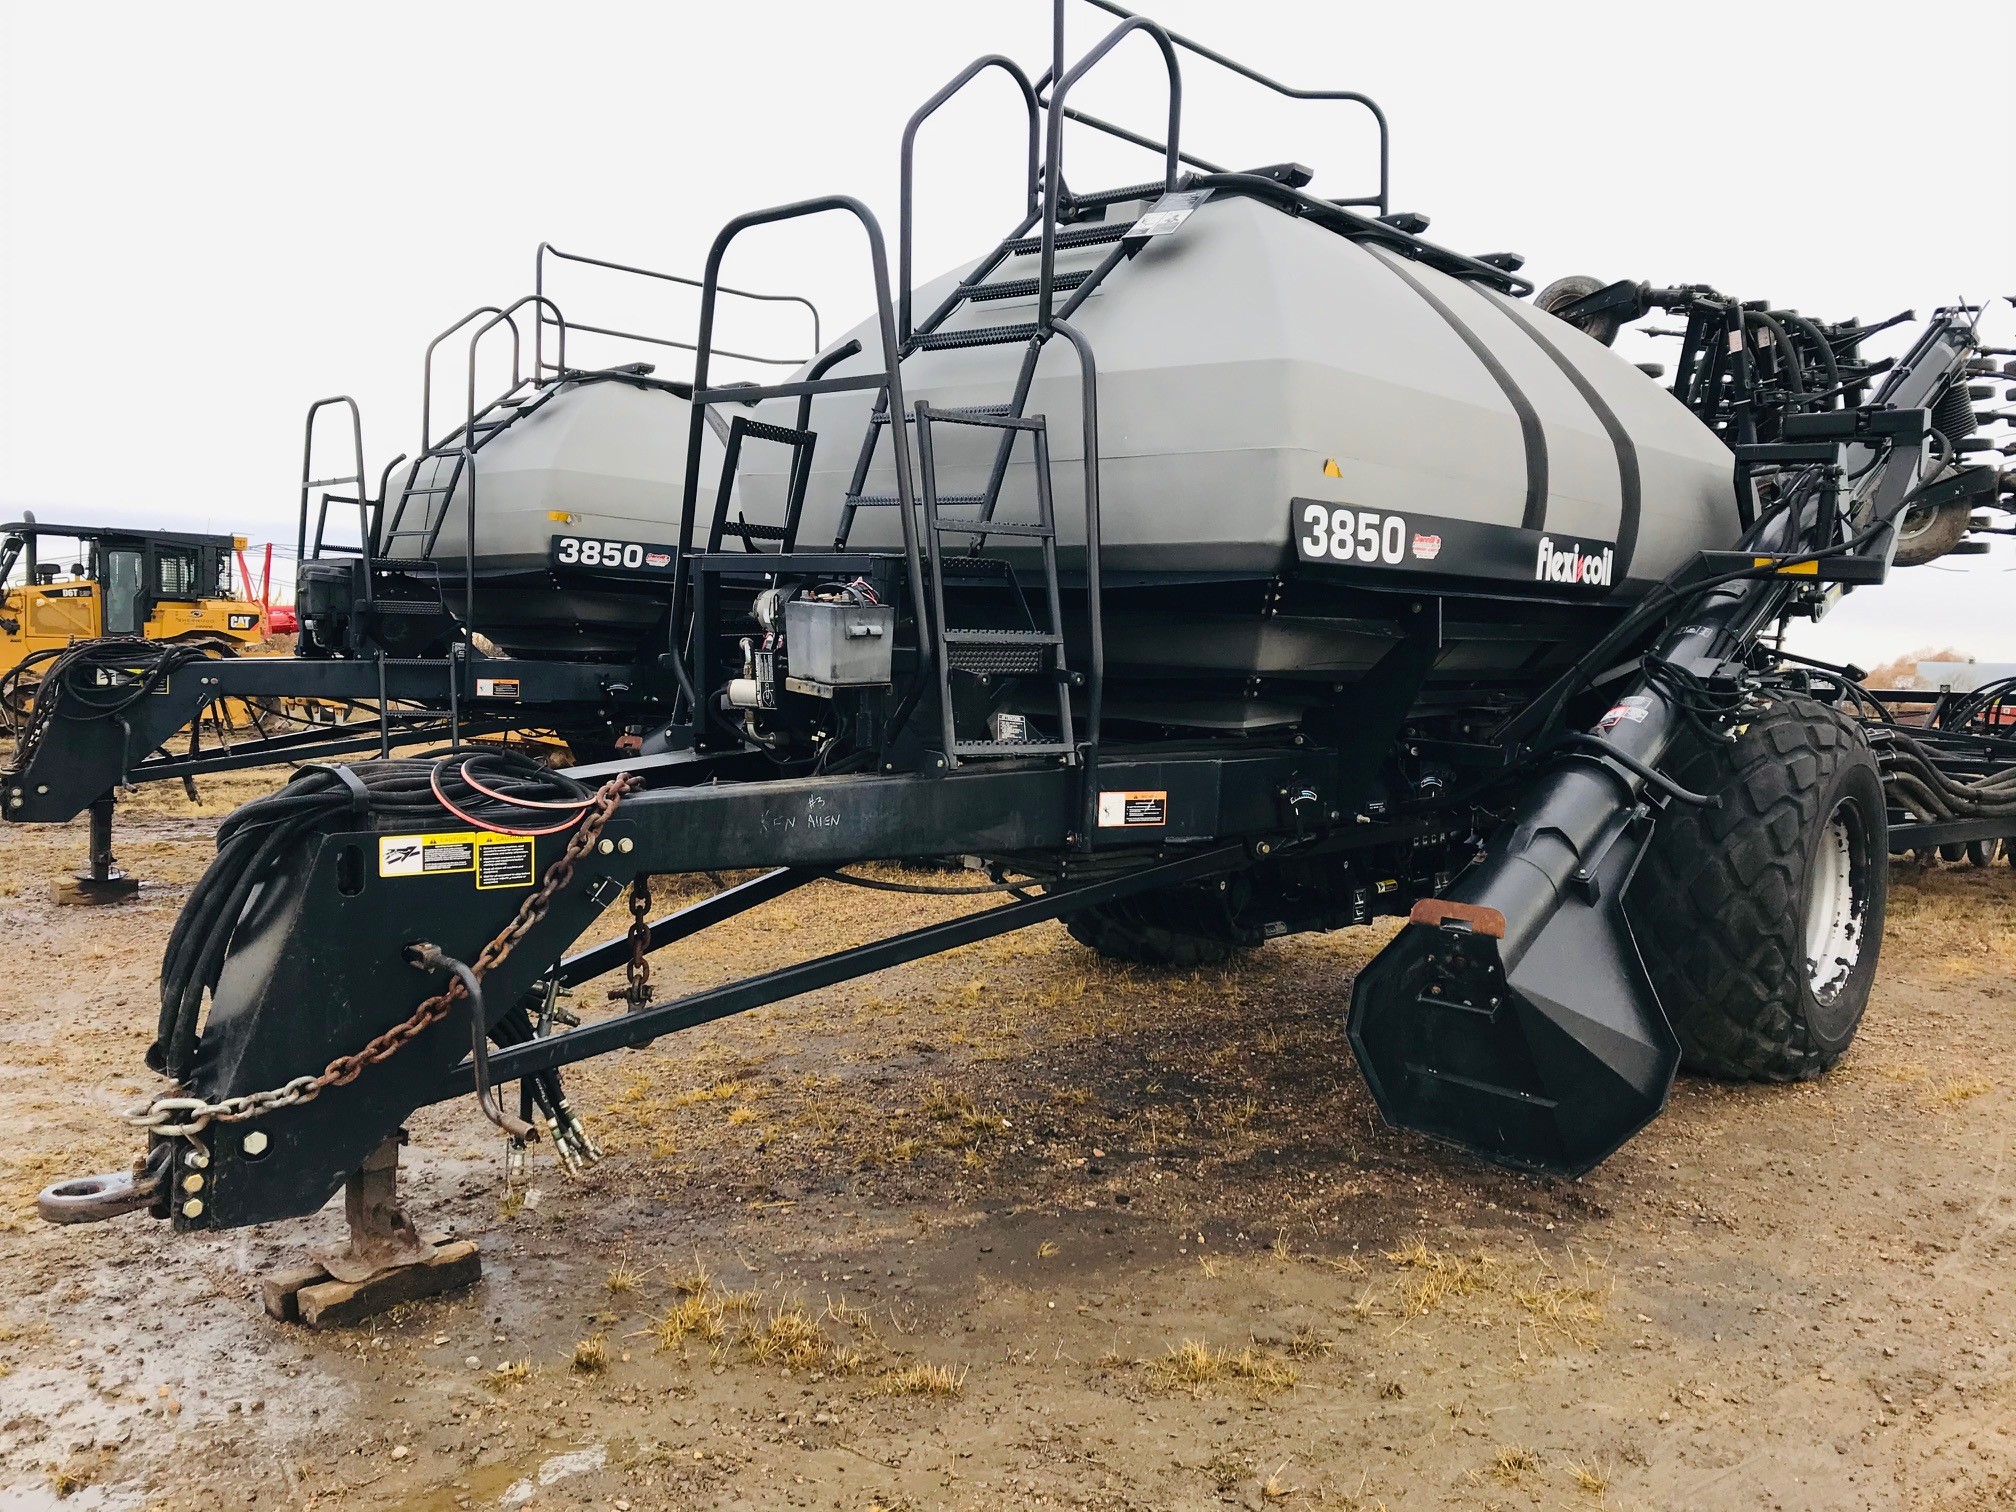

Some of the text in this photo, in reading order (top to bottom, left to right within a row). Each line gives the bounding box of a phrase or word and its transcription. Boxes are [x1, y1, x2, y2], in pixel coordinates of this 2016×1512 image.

[1302, 504, 1406, 565] 3850
[558, 538, 644, 569] 3850
[62, 588, 79, 597] D6T
[230, 615, 251, 629] CAT
[439, 836, 468, 844] CAUTION
